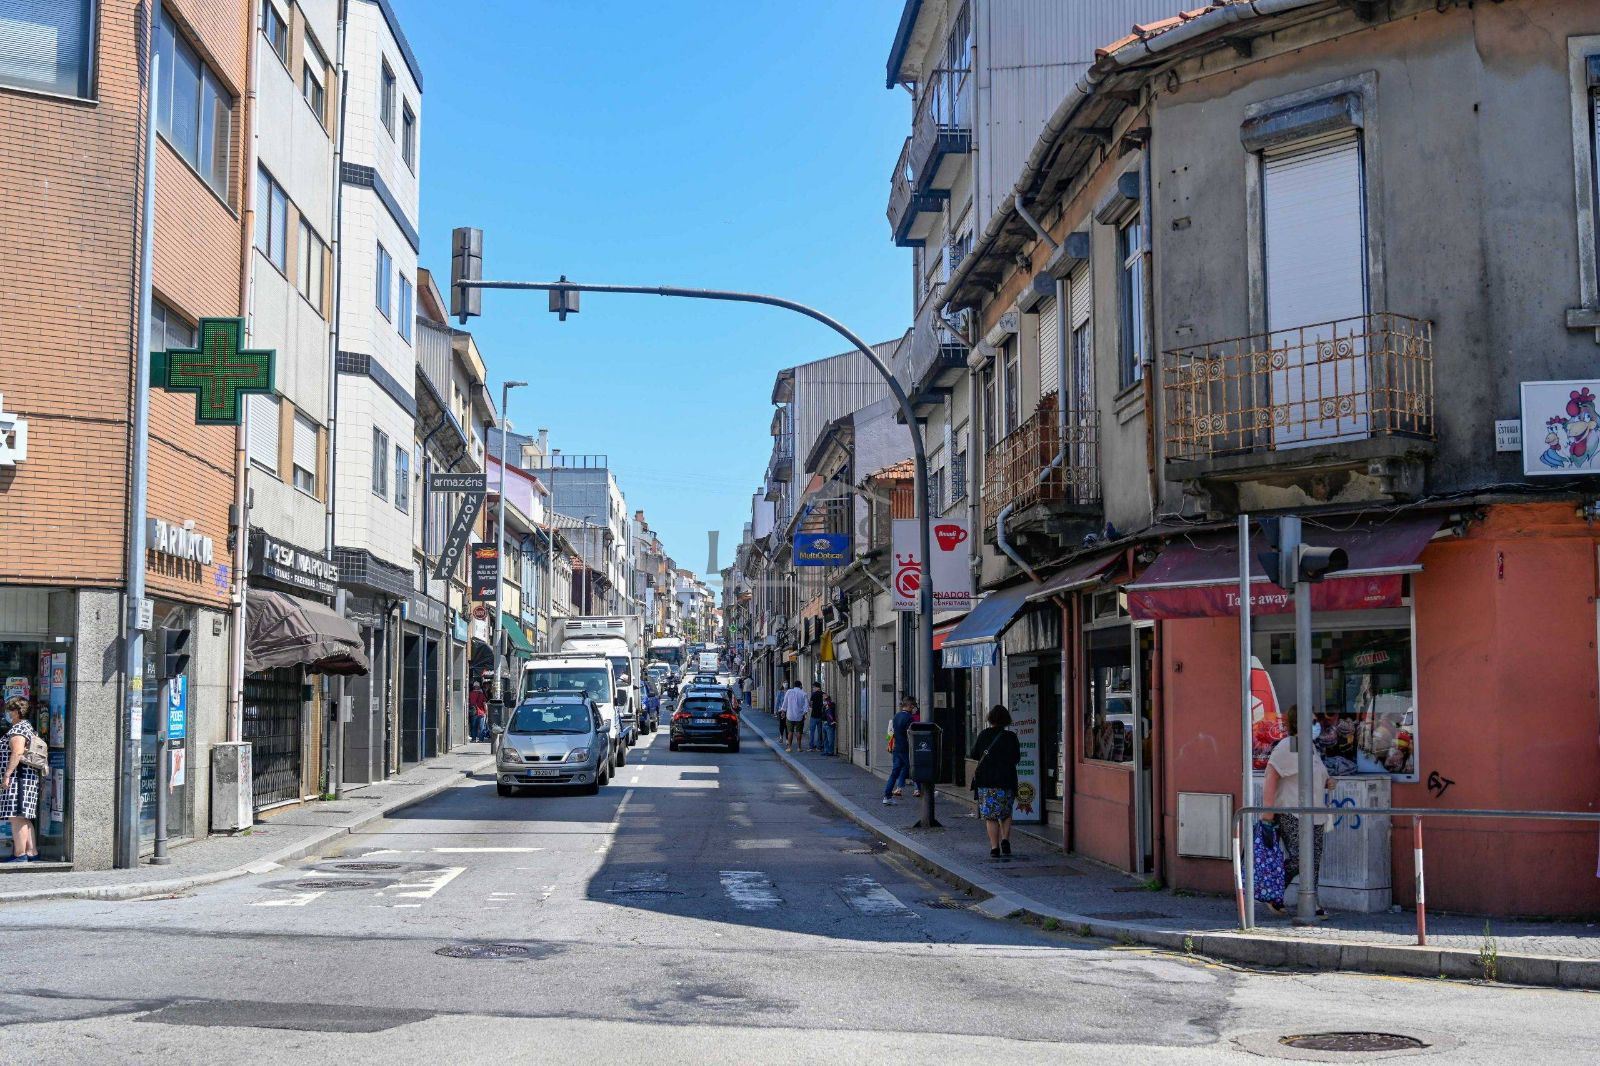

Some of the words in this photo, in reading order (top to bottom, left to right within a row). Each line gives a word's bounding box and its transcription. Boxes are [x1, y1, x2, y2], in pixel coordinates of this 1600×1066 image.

[434, 477, 483, 487] armazéns
[457, 495, 477, 532] NOVA
[296, 552, 338, 582] MARQUES
[1225, 593, 1256, 606] Tae
[1258, 594, 1288, 608] away
